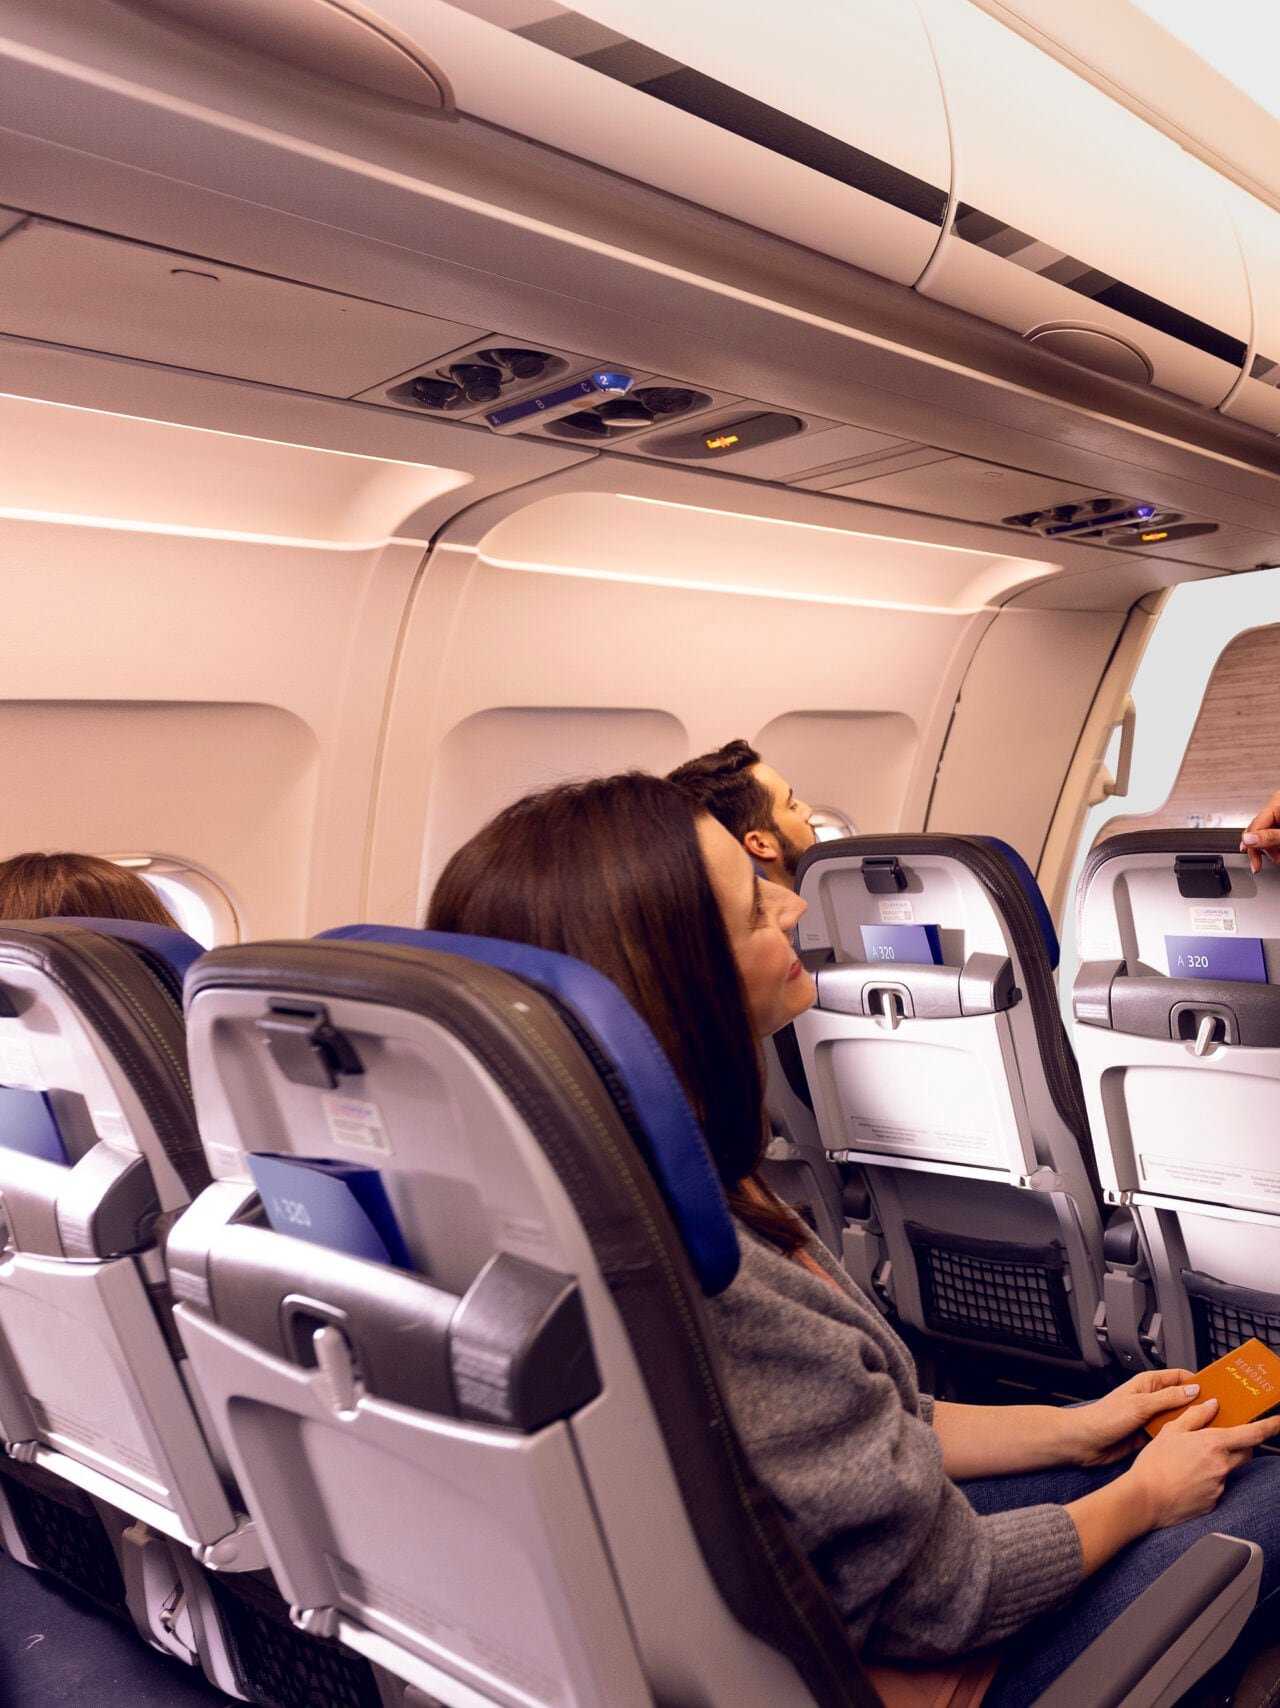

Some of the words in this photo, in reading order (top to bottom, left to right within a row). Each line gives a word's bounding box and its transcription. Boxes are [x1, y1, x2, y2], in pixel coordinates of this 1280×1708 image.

[600, 375, 609, 386] 2
[879, 946, 895, 960] 320
[1176, 954, 1185, 966] A
[1187, 956, 1208, 968] 320
[282, 1198, 312, 1227] 320
[1234, 1358, 1274, 1392] MEMORIES
